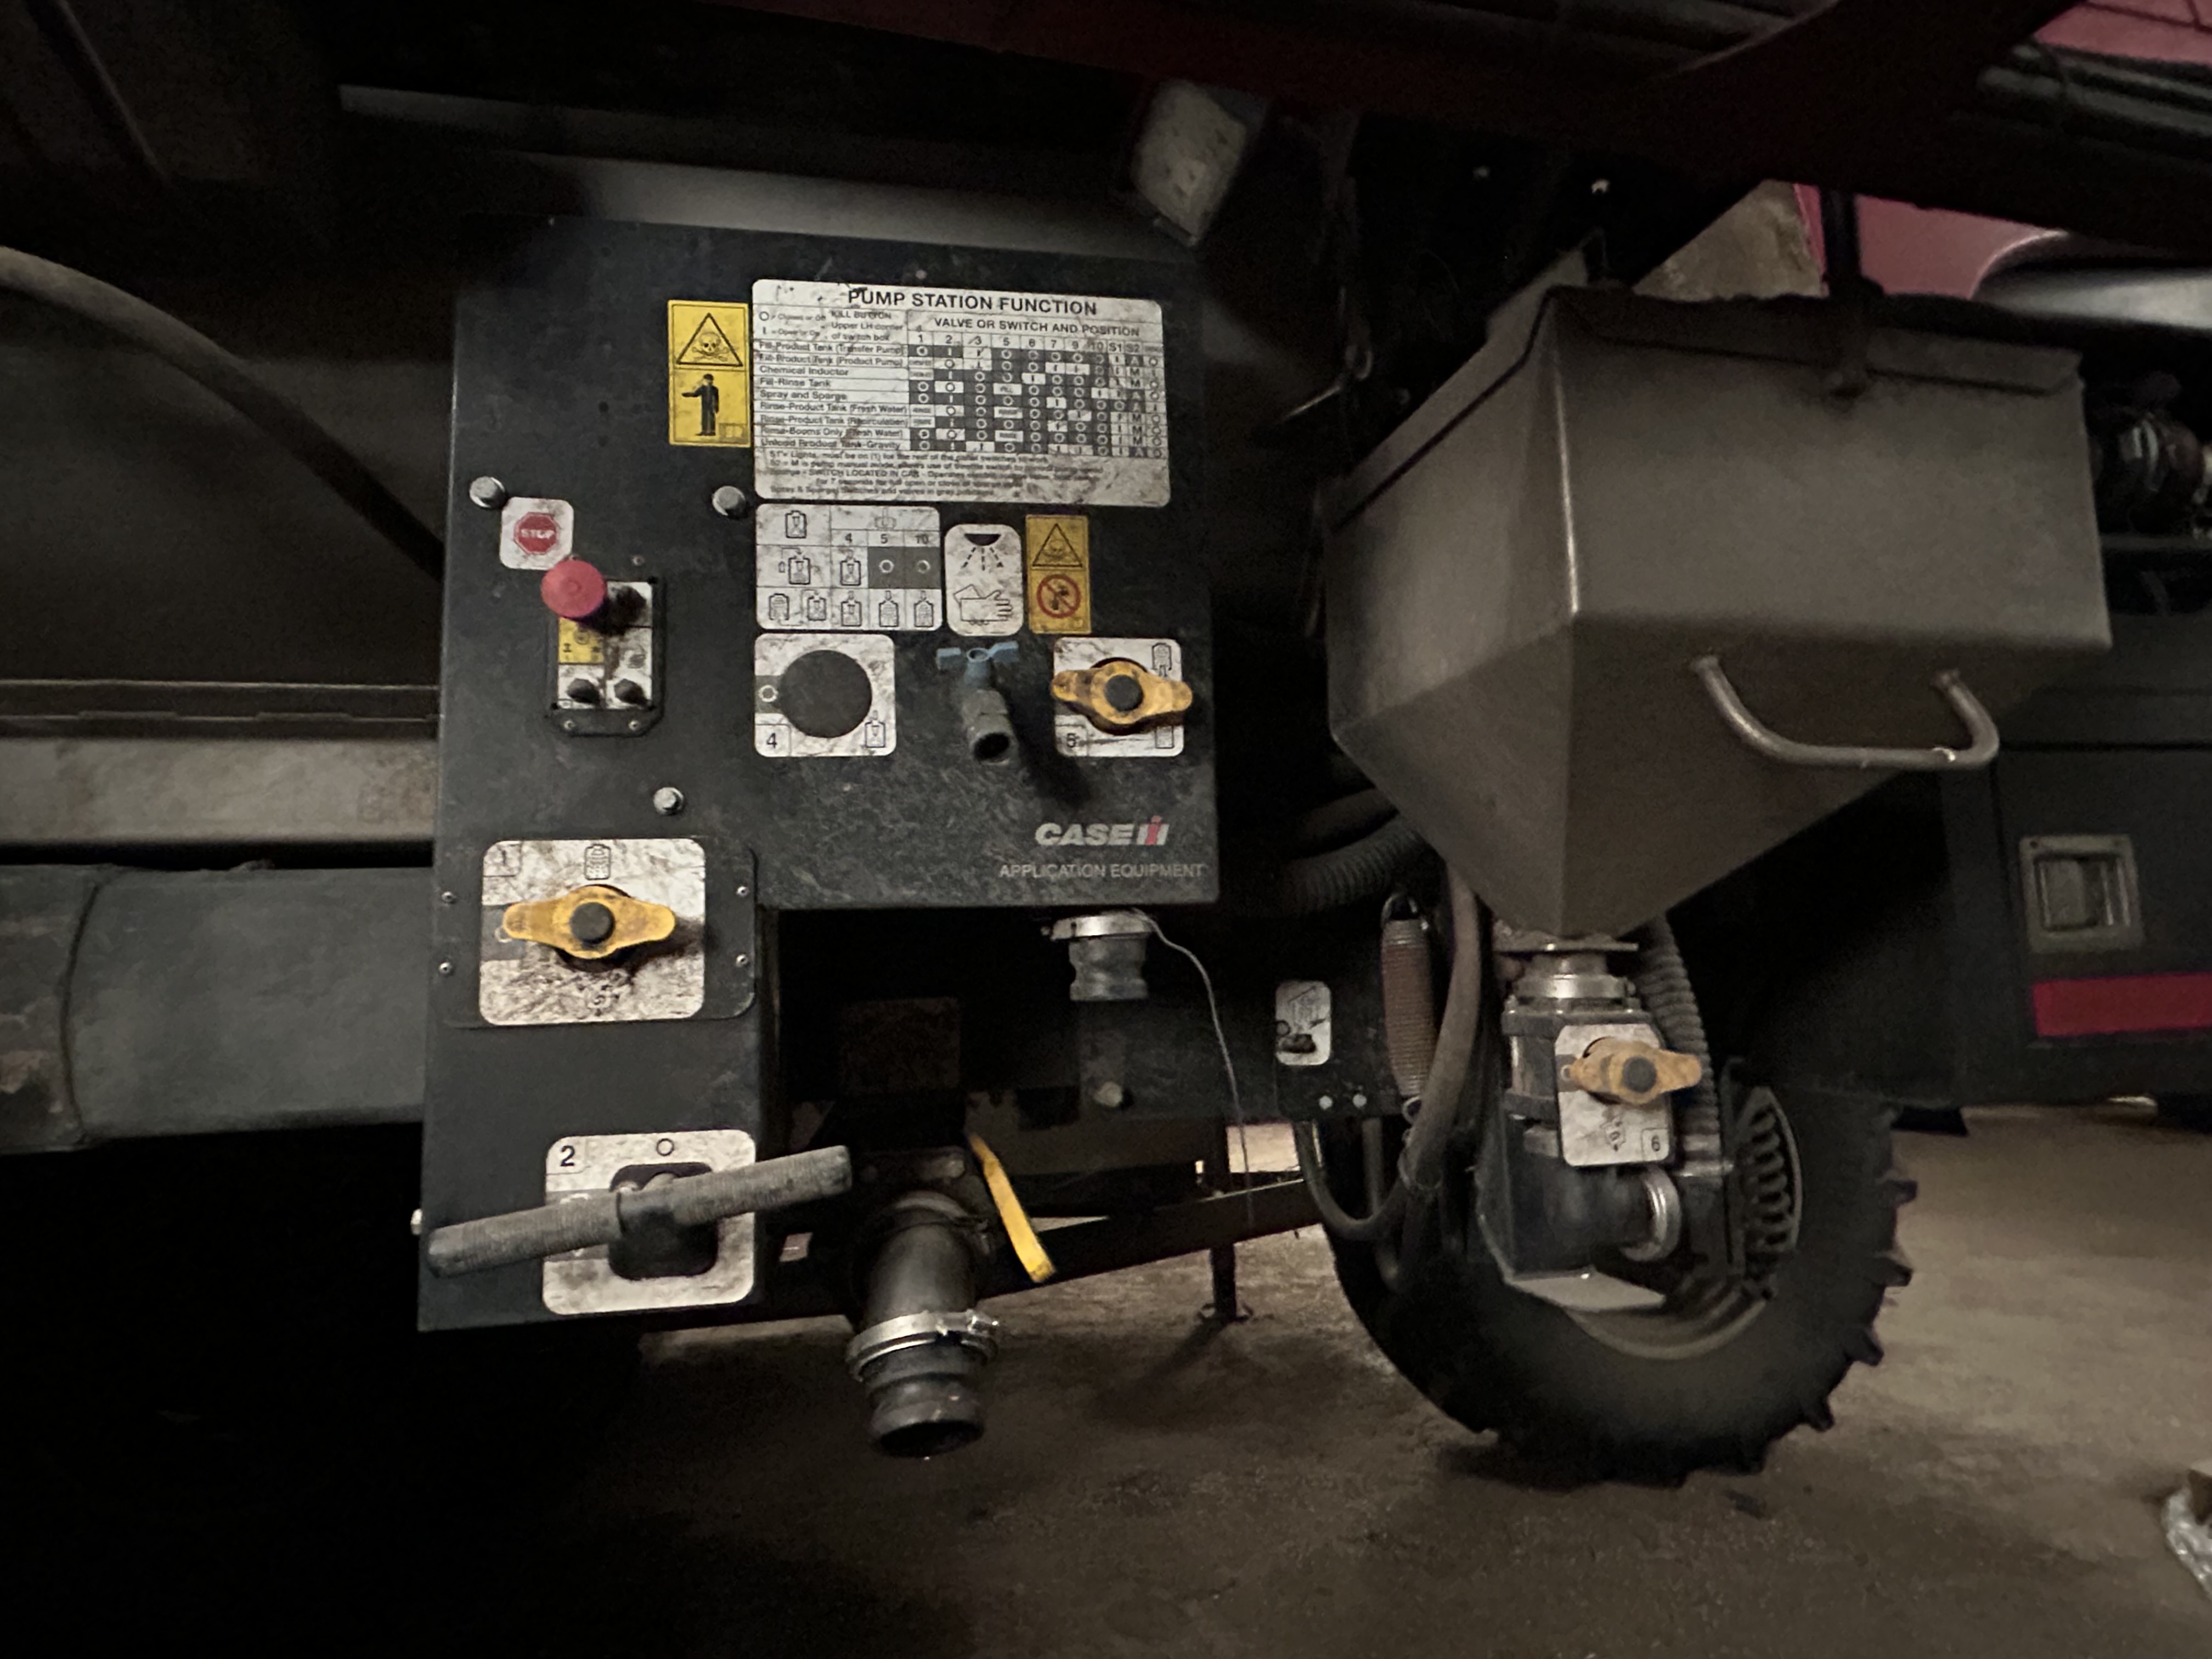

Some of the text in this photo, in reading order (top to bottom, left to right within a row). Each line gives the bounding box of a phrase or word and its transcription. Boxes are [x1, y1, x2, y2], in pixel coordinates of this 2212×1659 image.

[848, 290, 1097, 315] PUMP STATION FUNCTION
[831, 319, 858, 329] Upper
[860, 320, 873, 329] LH
[934, 318, 1139, 336] VALVE OR SWITCH AND POSITION
[836, 343, 873, 354] (Transfer
[877, 346, 904, 355] Pump)
[918, 334, 923, 342] 1
[945, 335, 952, 344] 2
[975, 336, 982, 345] 3
[1003, 337, 1010, 346] 5
[1051, 340, 1057, 348] 7
[1071, 341, 1079, 349] 9
[1108, 342, 1122, 352] S1
[1125, 343, 1140, 352] S2
[836, 357, 873, 365] (Product
[876, 358, 903, 367] Pump)
[759, 366, 805, 374] Chemical
[760, 390, 788, 399] Spray
[812, 391, 847, 402] Sparge
[826, 404, 847, 412] Tank
[850, 404, 877, 413] (Fresh
[879, 405, 907, 414] Water)
[823, 428, 843, 437] Only
[761, 438, 796, 447] Unload
[798, 439, 837, 448] Product
[521, 529, 555, 539] STOP
[881, 533, 888, 544] 5
[916, 534, 929, 544] 10
[766, 733, 777, 749] 4
[1035, 822, 1135, 845] CASE
[998, 863, 1205, 878] APPLICATION EQUIPMENT
[1651, 1135, 1660, 1152] 6
[561, 1146, 575, 1166] 2
